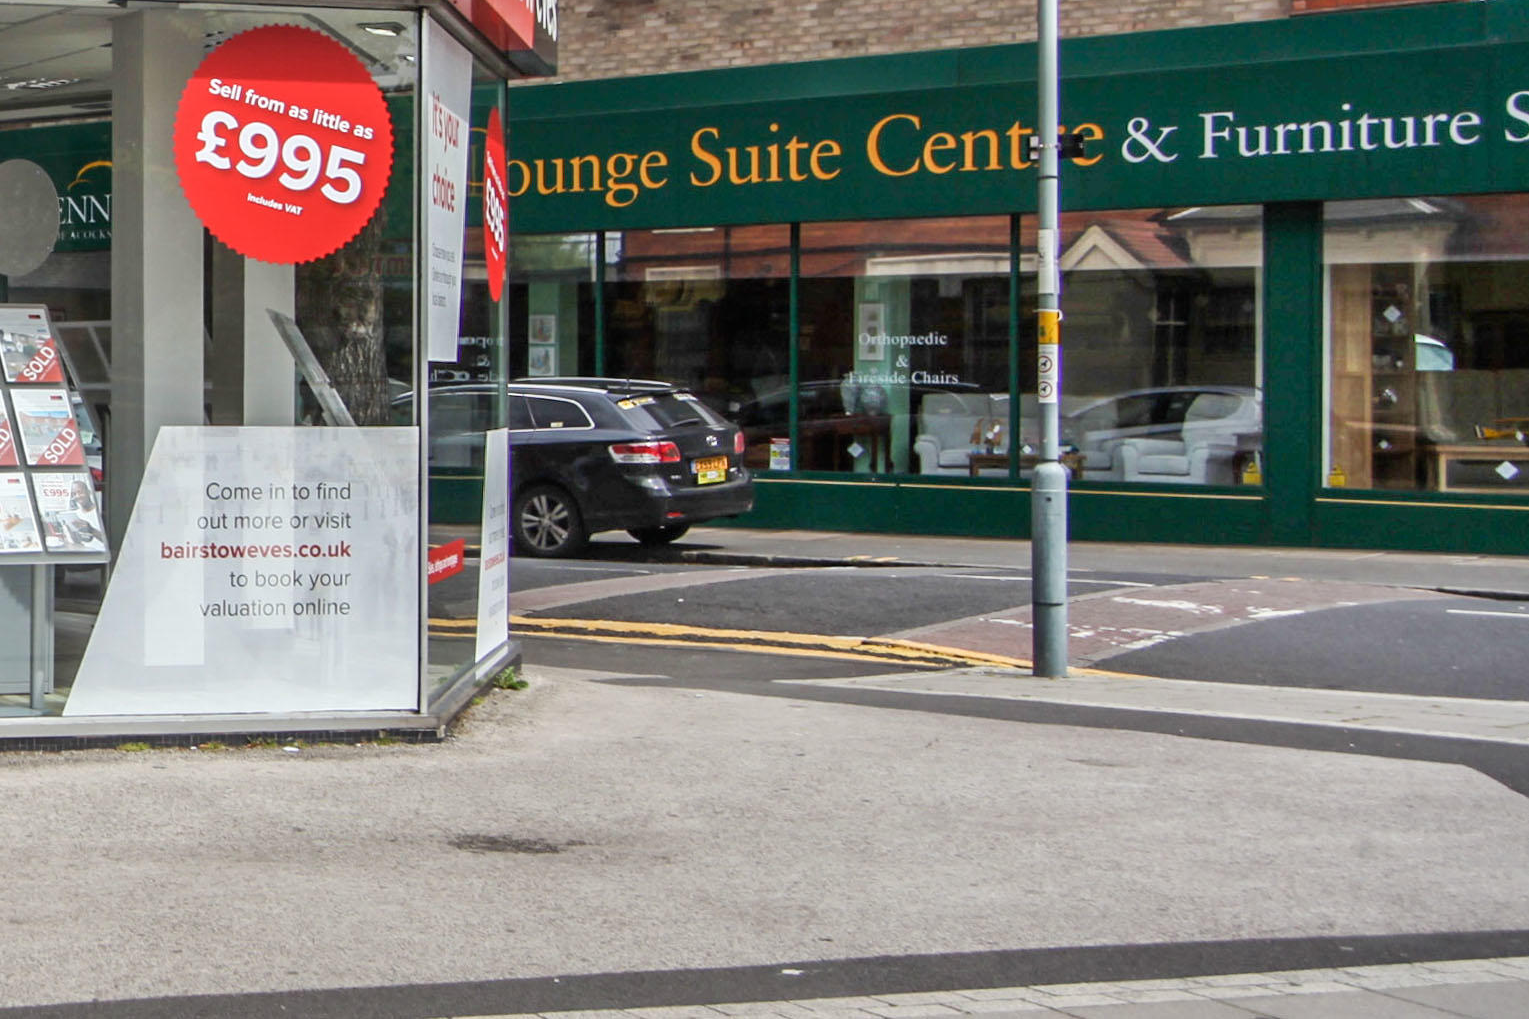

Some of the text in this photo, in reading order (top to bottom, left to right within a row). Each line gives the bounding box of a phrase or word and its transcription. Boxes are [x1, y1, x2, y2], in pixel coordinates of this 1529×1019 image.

[208, 78, 374, 140] Sell from as little as
[195, 110, 366, 204] £995
[507, 147, 669, 207] ounge
[689, 122, 841, 187] Suite
[866, 113, 1105, 177] Cente
[1121, 116, 1179, 163] &
[1198, 103, 1481, 159] Furniture
[247, 193, 303, 216] Includes VAT
[858, 332, 948, 348] Orthopaedic
[23, 345, 55, 381] SOLD
[895, 354, 909, 368] &
[911, 371, 959, 385] Chairs
[44, 427, 77, 465] SOLD
[43, 488, 69, 497] £995
[206, 482, 351, 500] Come in to find
[197, 512, 352, 530] out more or visit
[161, 541, 351, 559] bairstoweves.co.uk
[229, 570, 351, 591] to book your
[199, 599, 351, 617] valuation online
